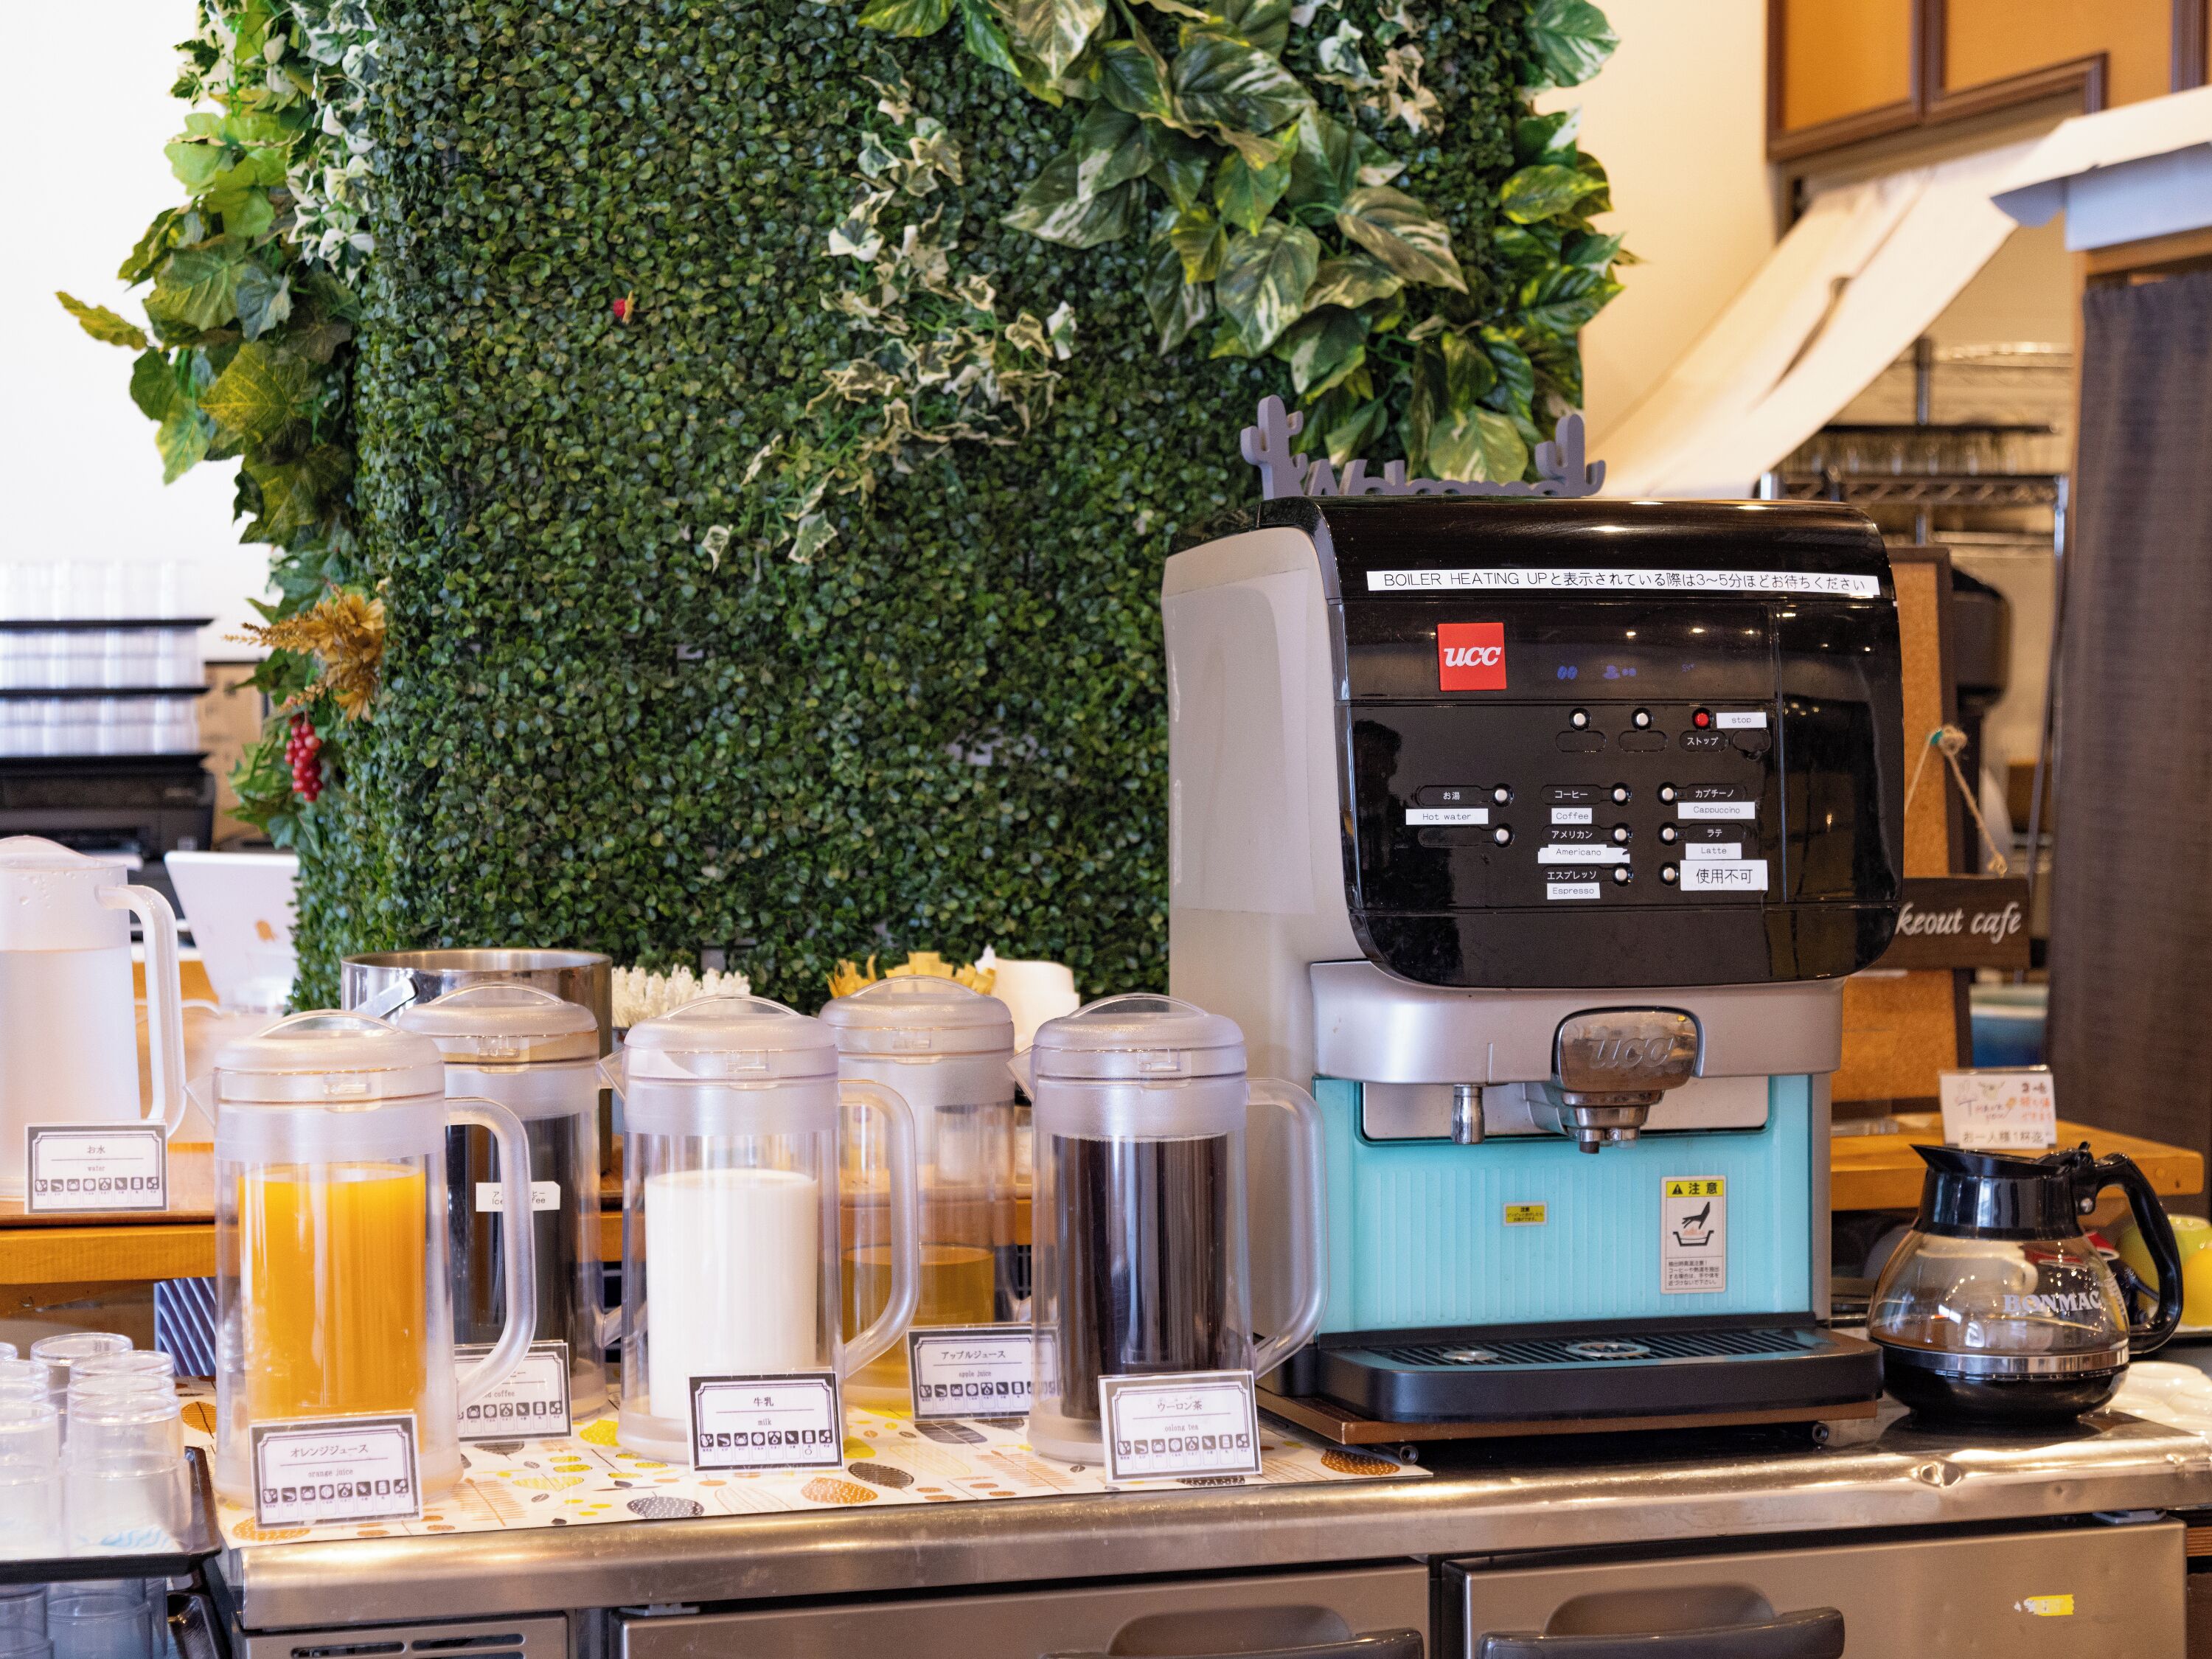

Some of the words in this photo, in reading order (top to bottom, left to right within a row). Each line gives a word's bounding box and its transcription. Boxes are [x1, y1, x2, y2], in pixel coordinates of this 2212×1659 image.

[1383, 573, 1442, 587] BOILER
[1450, 572, 1520, 586] HEATING
[1731, 717, 1752, 725] stop
[1686, 737, 1719, 746] ストップ
[1442, 790, 1461, 801] お湯
[1554, 790, 1588, 799] コーヒー
[1694, 788, 1735, 799] カプチーノ
[1693, 806, 1741, 815] Cappuccino
[1422, 813, 1440, 821] Hot
[1555, 812, 1589, 821] Coffee
[1551, 830, 1593, 840] アメリカン
[1706, 828, 1723, 838] ラテ
[1555, 847, 1602, 857] Americano
[1700, 846, 1728, 855] Latte
[1547, 870, 1597, 880] エスプレッソ
[1695, 868, 1753, 885] 使用不可
[1552, 887, 1595, 897] Espresso
[1895, 901, 1964, 936] keout
[86, 1145, 106, 1155] お水
[1688, 1182, 1718, 1195] 注意
[2003, 1290, 2101, 1312] BONMAC
[941, 1350, 1006, 1361] アップルジュース
[494, 1389, 516, 1398] coffee
[753, 1397, 774, 1408] 牛乳
[1157, 1400, 1203, 1412] ウーロン茶
[1164, 1425, 1186, 1433] oolong
[290, 1444, 369, 1458] オレンジジュース
[307, 1470, 333, 1478] orange
[335, 1468, 354, 1477] juice
